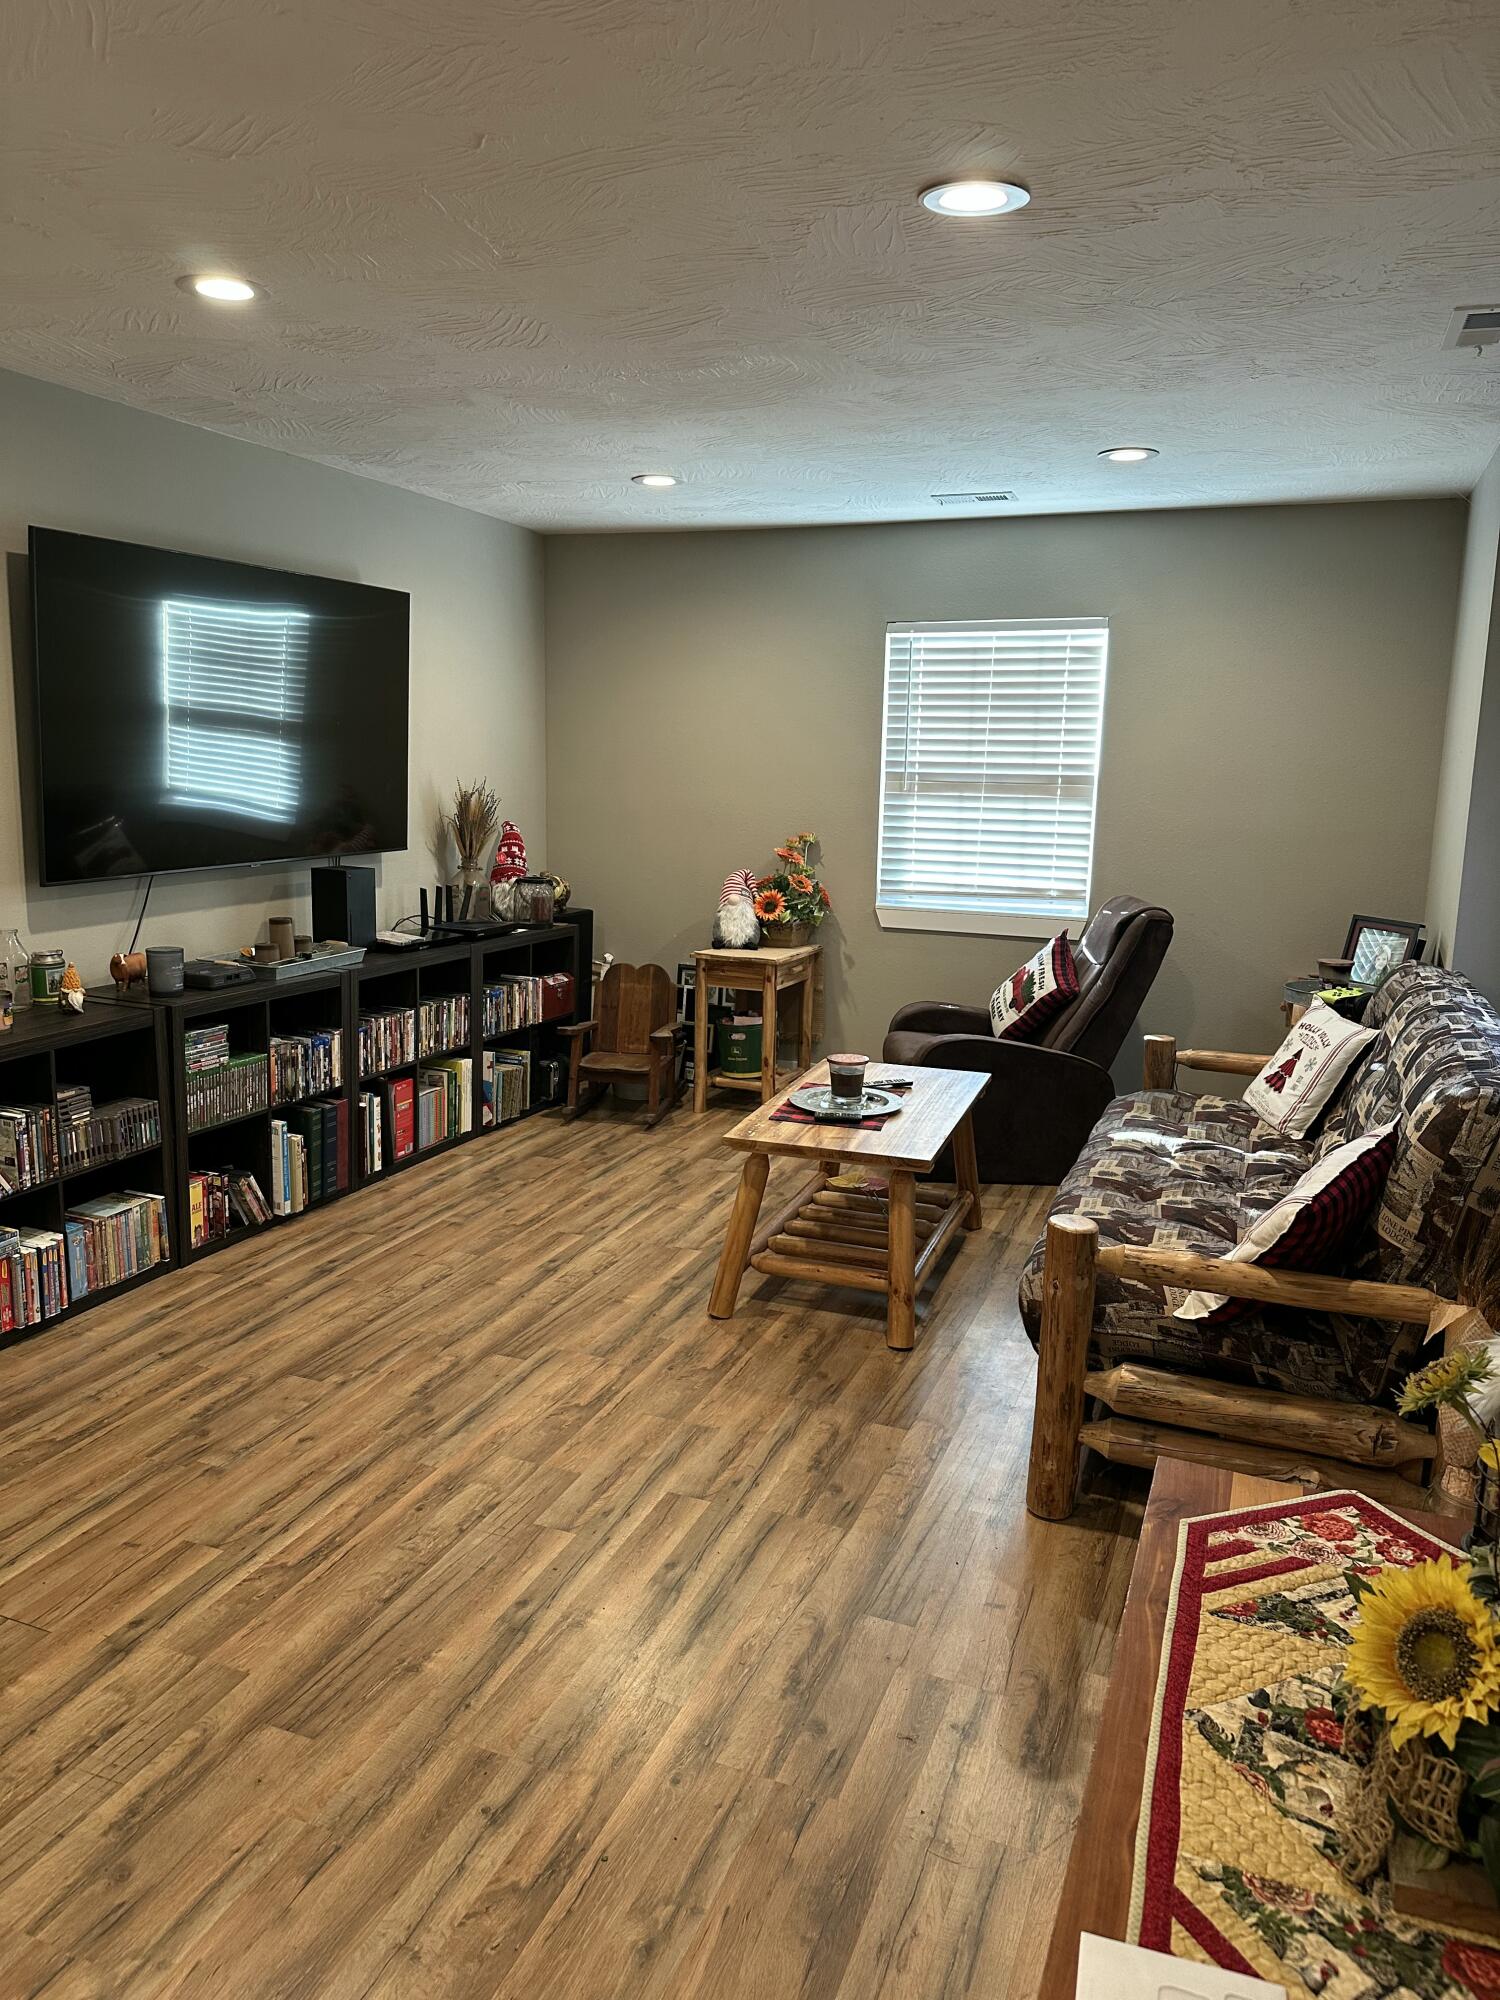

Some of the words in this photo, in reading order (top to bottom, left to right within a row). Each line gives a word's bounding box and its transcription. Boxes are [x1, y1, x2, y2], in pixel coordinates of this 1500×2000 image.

[1298, 1021, 1321, 1033] HOLLY
[1319, 1029, 1332, 1049] JOLLY
[1381, 1212, 1399, 1231] LONE
[1382, 1225, 1407, 1244] LODGE
